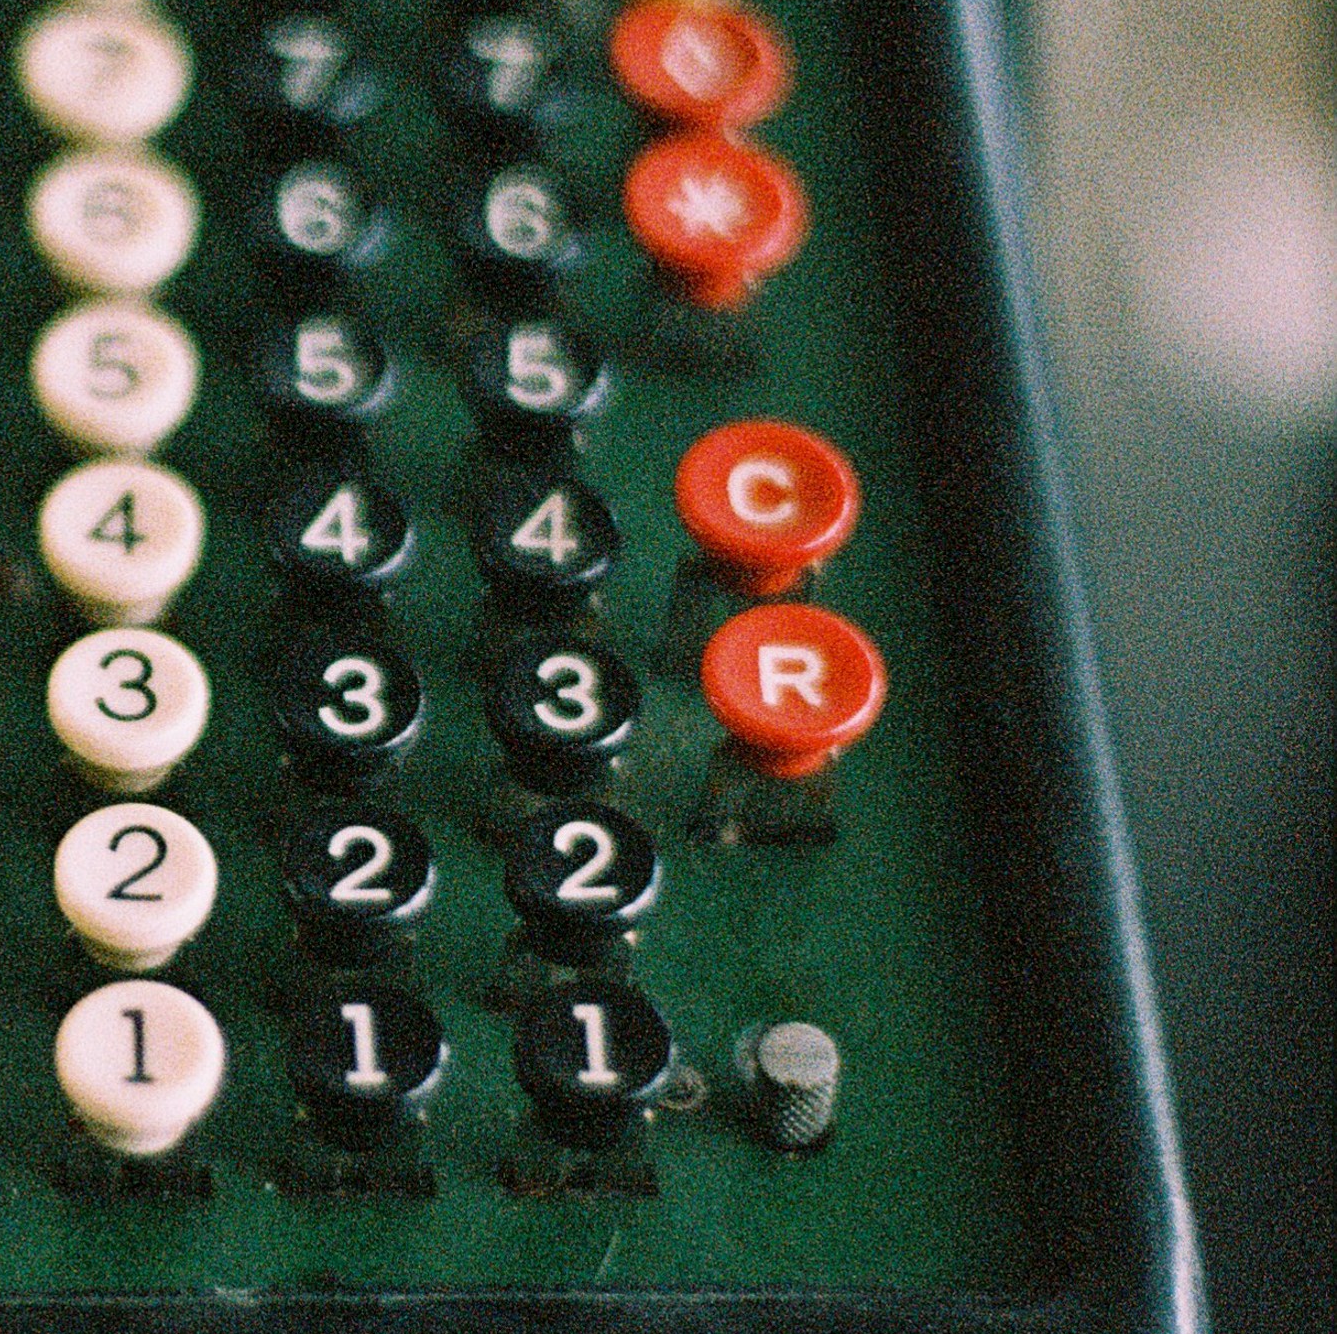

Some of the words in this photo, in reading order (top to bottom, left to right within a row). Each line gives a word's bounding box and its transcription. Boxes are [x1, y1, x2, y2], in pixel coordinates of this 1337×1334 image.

[277, 163, 353, 255] 6
[486, 169, 557, 257] 6
[85, 331, 145, 400] 5
[295, 320, 355, 406] 5
[506, 323, 567, 409] 5
[90, 494, 142, 553] 4
[300, 486, 368, 564] 4
[510, 490, 578, 565] 4
[726, 461, 793, 525] C
[93, 648, 158, 722] 3
[317, 656, 385, 737] 3
[532, 653, 600, 733] 3
[759, 645, 824, 706] R
[106, 824, 168, 901] 2
[328, 824, 391, 901] 2
[551, 820, 617, 901] 2
[120, 1009, 155, 1084] 1
[340, 1003, 387, 1086] 1
[572, 1005, 617, 1086] 1
